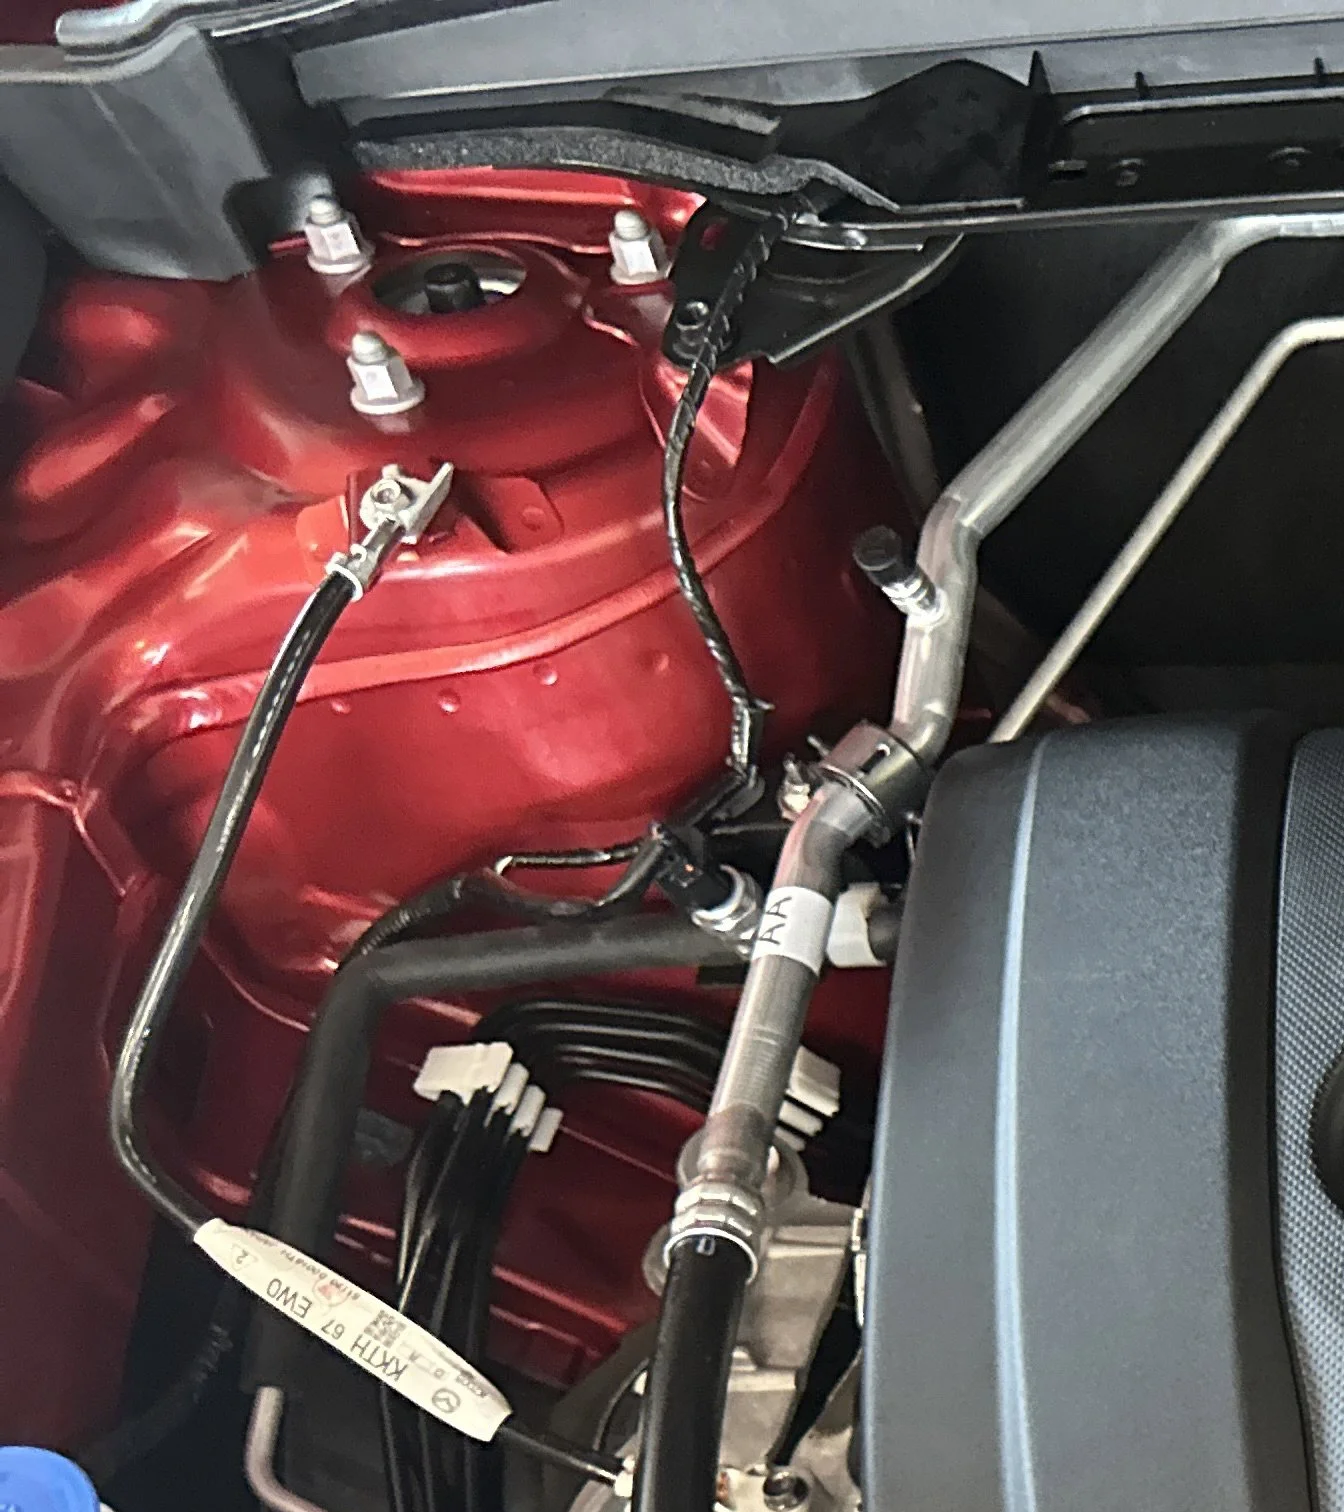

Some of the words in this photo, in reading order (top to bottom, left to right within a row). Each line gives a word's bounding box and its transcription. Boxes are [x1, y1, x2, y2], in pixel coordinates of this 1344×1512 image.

[759, 896, 792, 946] AA
[321, 1318, 346, 1340] 67
[350, 1333, 409, 1382] KKTH
